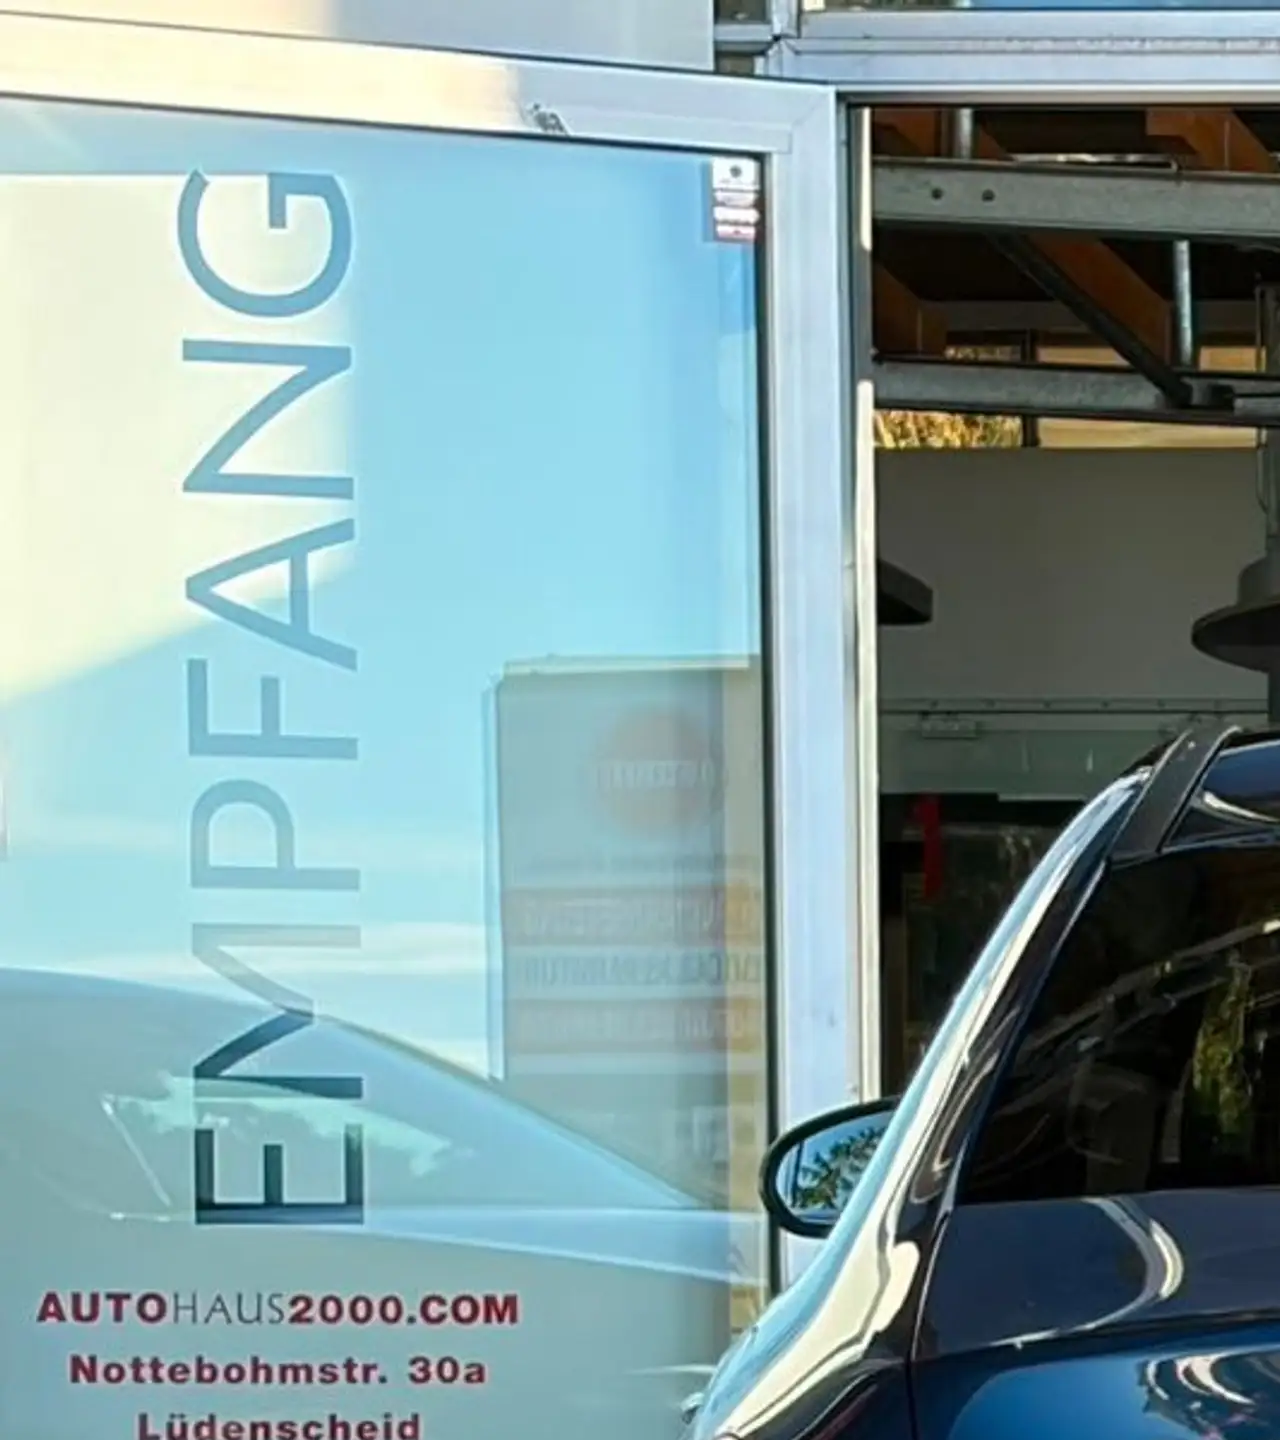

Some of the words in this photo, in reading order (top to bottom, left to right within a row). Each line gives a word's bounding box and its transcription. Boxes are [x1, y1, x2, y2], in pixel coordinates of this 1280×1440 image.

[177, 168, 363, 1225] EMPFANG
[36, 1292, 520, 1325] AUTOHAUS2000.COM
[69, 1354, 388, 1385] Nottebohmstr.
[407, 1357, 487, 1384] 30a
